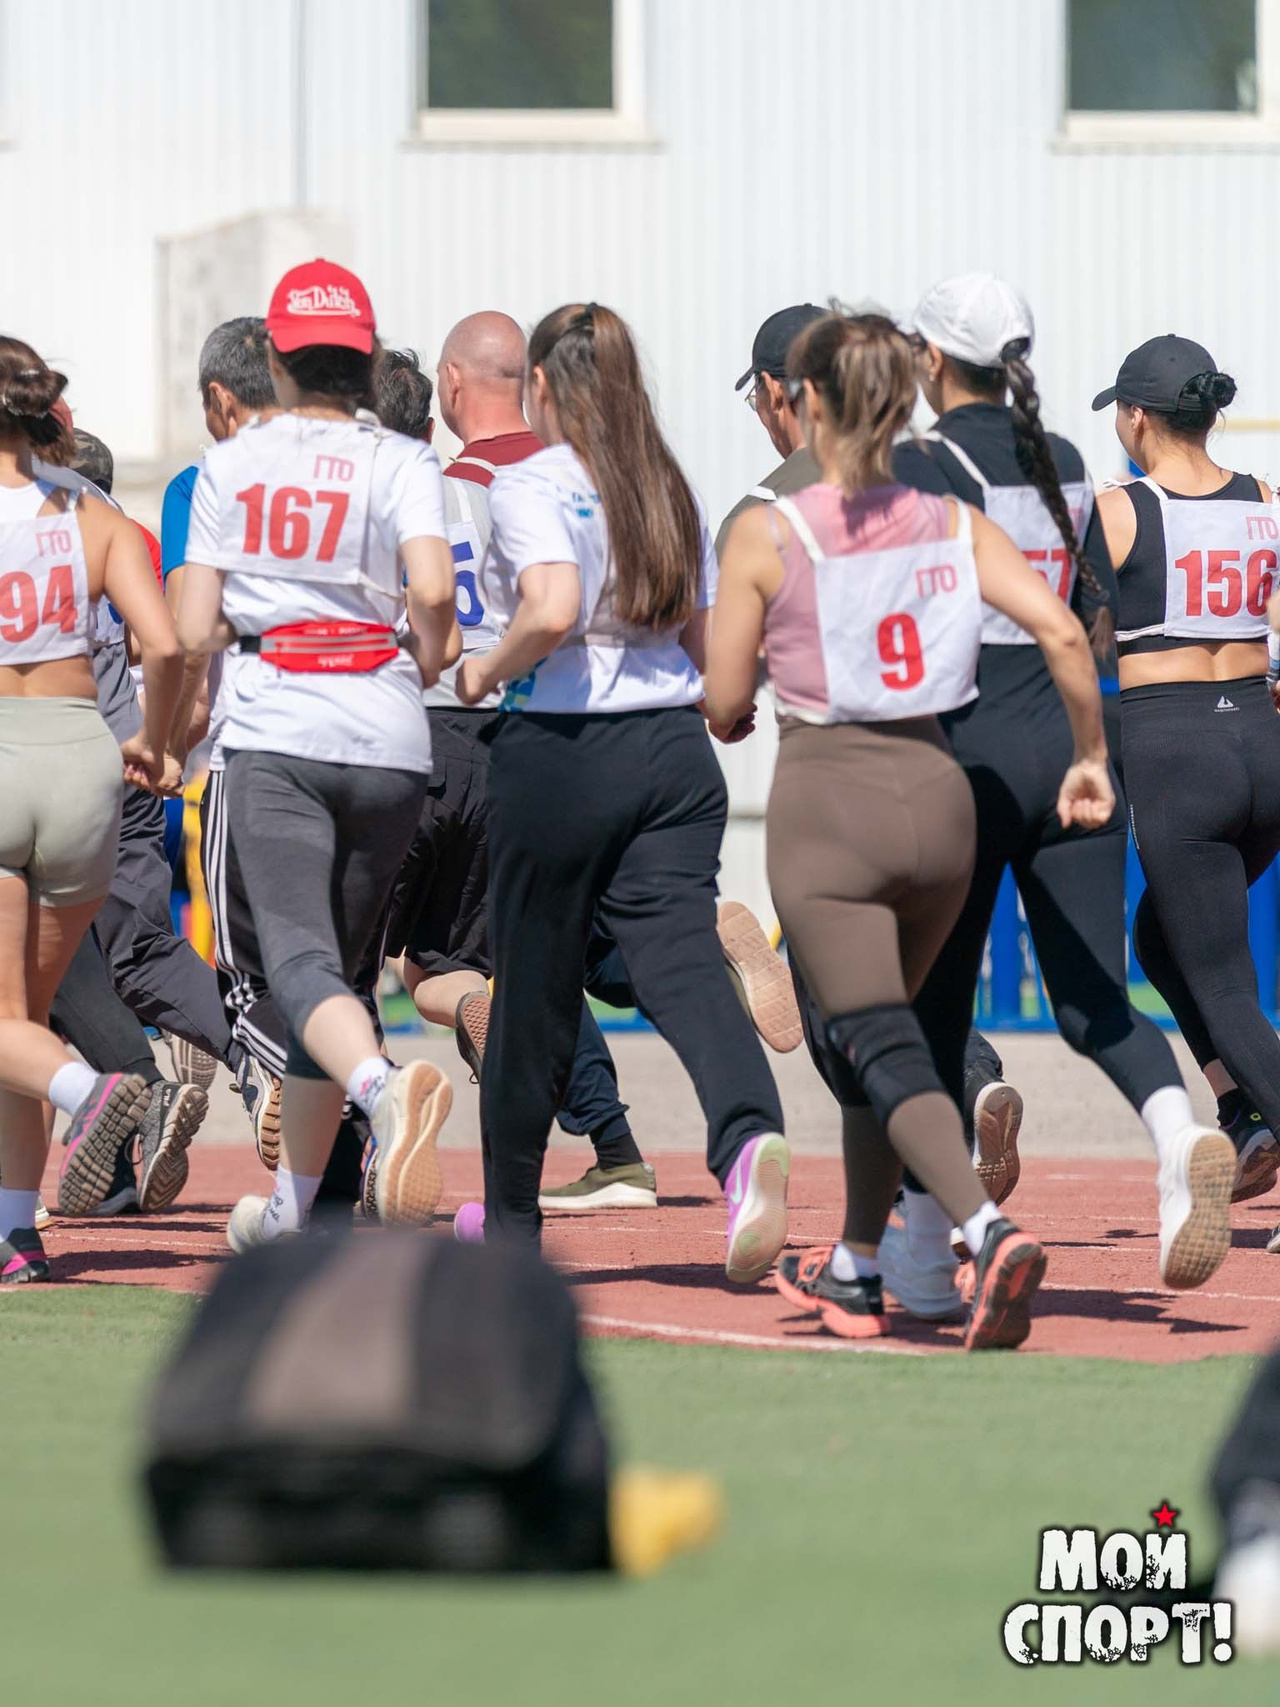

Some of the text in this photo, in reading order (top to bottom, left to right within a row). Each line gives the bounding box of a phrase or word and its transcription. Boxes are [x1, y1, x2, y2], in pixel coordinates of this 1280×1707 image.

[313, 454, 355, 483] ГТО
[235, 482, 351, 564] 167
[1245, 516, 1280, 541] ГТО
[35, 529, 72, 558] ГТО
[915, 564, 958, 599] ГТО
[1174, 548, 1278, 618] 156
[877, 611, 925, 692] 9
